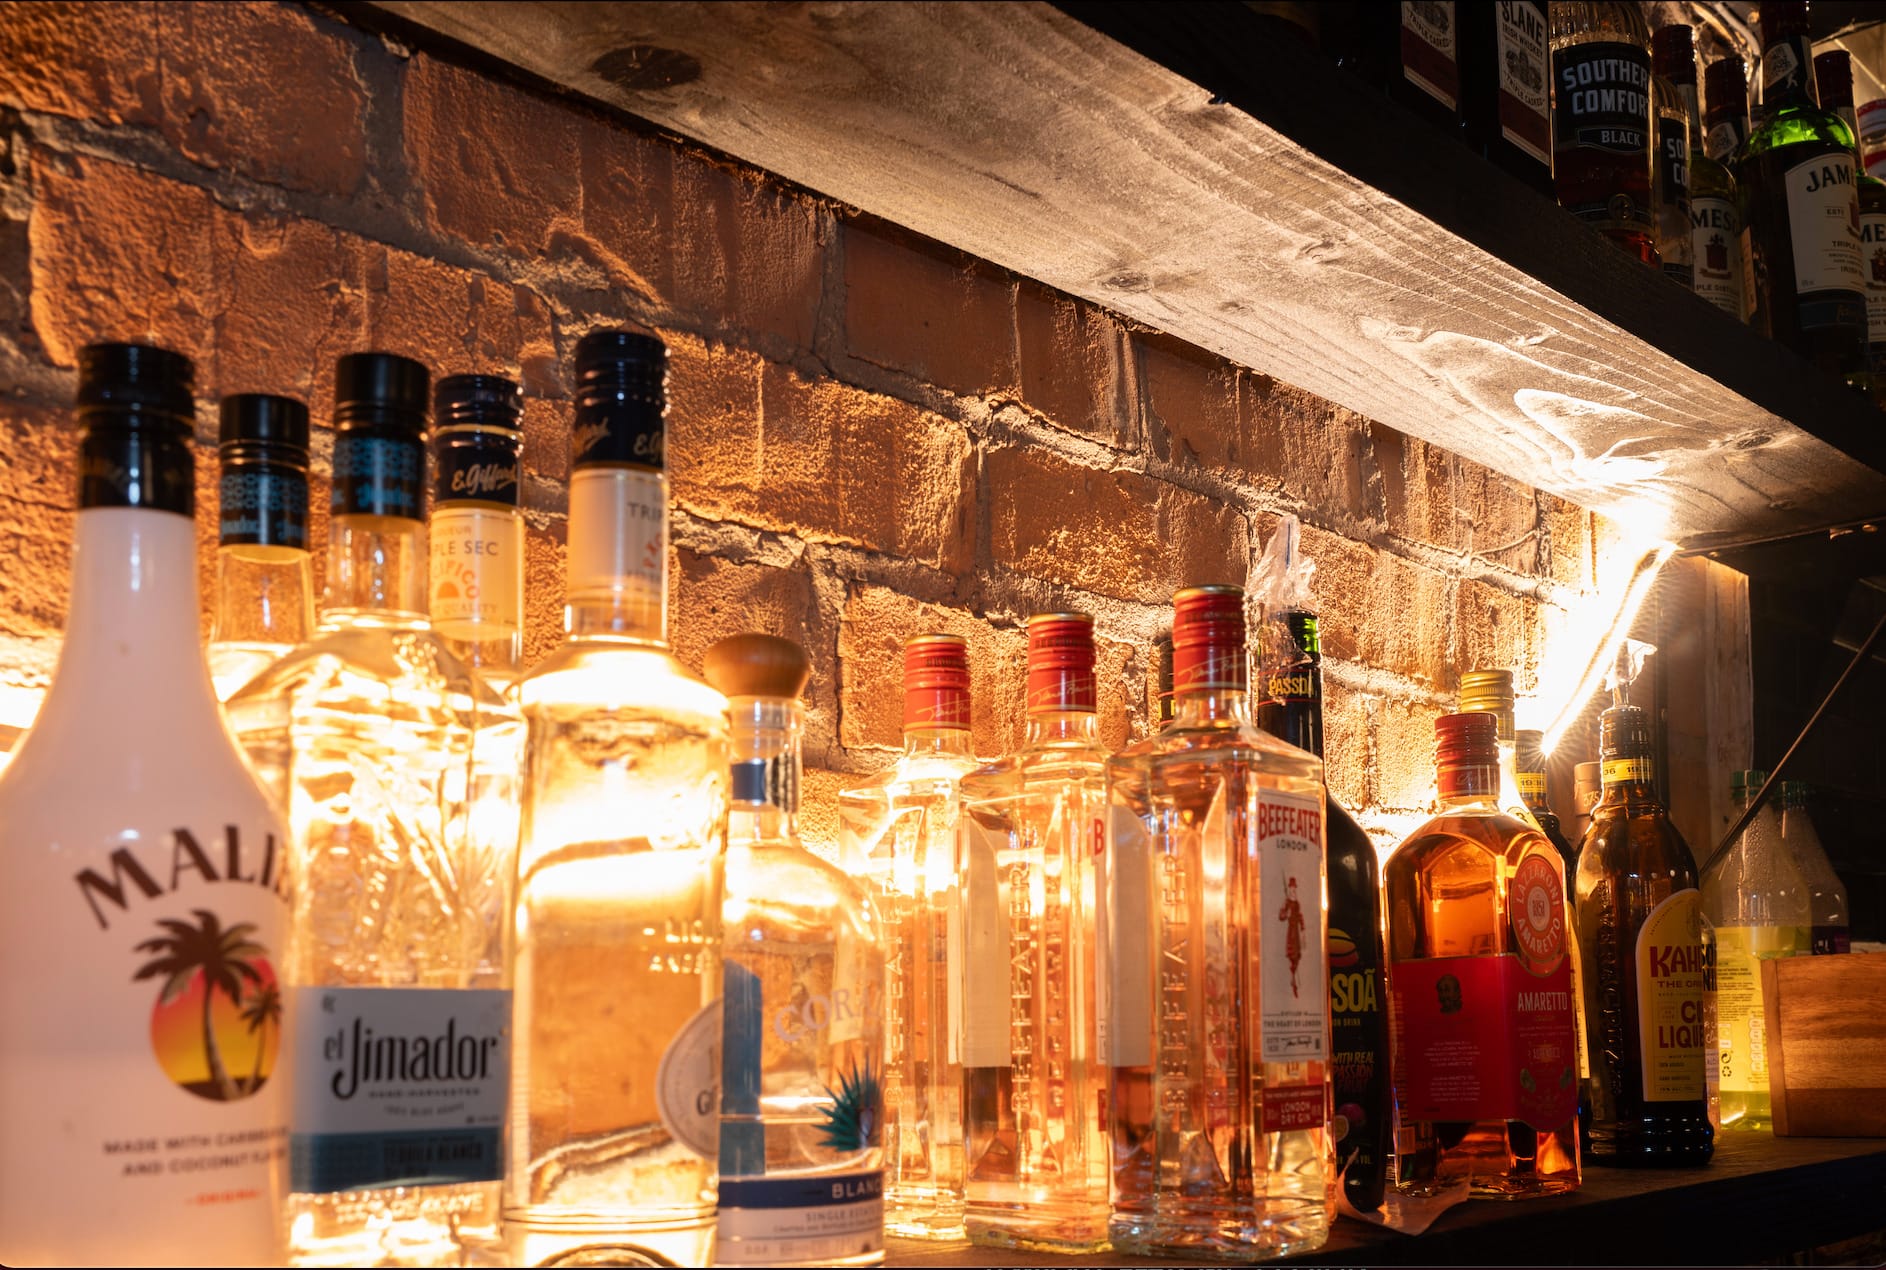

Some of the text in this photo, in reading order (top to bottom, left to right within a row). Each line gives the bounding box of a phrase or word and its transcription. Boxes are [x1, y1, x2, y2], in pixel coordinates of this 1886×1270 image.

[1501, 1, 1543, 47] SLANE
[1502, 22, 1543, 60] IRISH WHISKEY
[1562, 59, 1649, 91] SOUTHER
[1572, 89, 1649, 119] COMFOR
[1601, 130, 1641, 146] BLACK
[628, 503, 664, 519] TRIP
[464, 541, 499, 556] SEC
[1259, 802, 1321, 848] BEEFEATER
[1276, 838, 1308, 851] LONDON
[1516, 864, 1561, 905] LAZZARONI
[1517, 917, 1561, 954] AMARETTO
[1010, 866, 1033, 1112] BEEFEATER
[1162, 855, 1188, 1111] BEEFEATER
[1517, 991, 1568, 1012] AMARETTO
[323, 1015, 497, 1100] el Jimador
[1354, 1051, 1376, 1065] REAL
[1281, 1101, 1311, 1114] LONDON
[1281, 1113, 1296, 1126] DRY
[103, 1139, 157, 1156] MADE
[164, 1135, 212, 1151] WITH
[121, 1161, 163, 1178] AND
